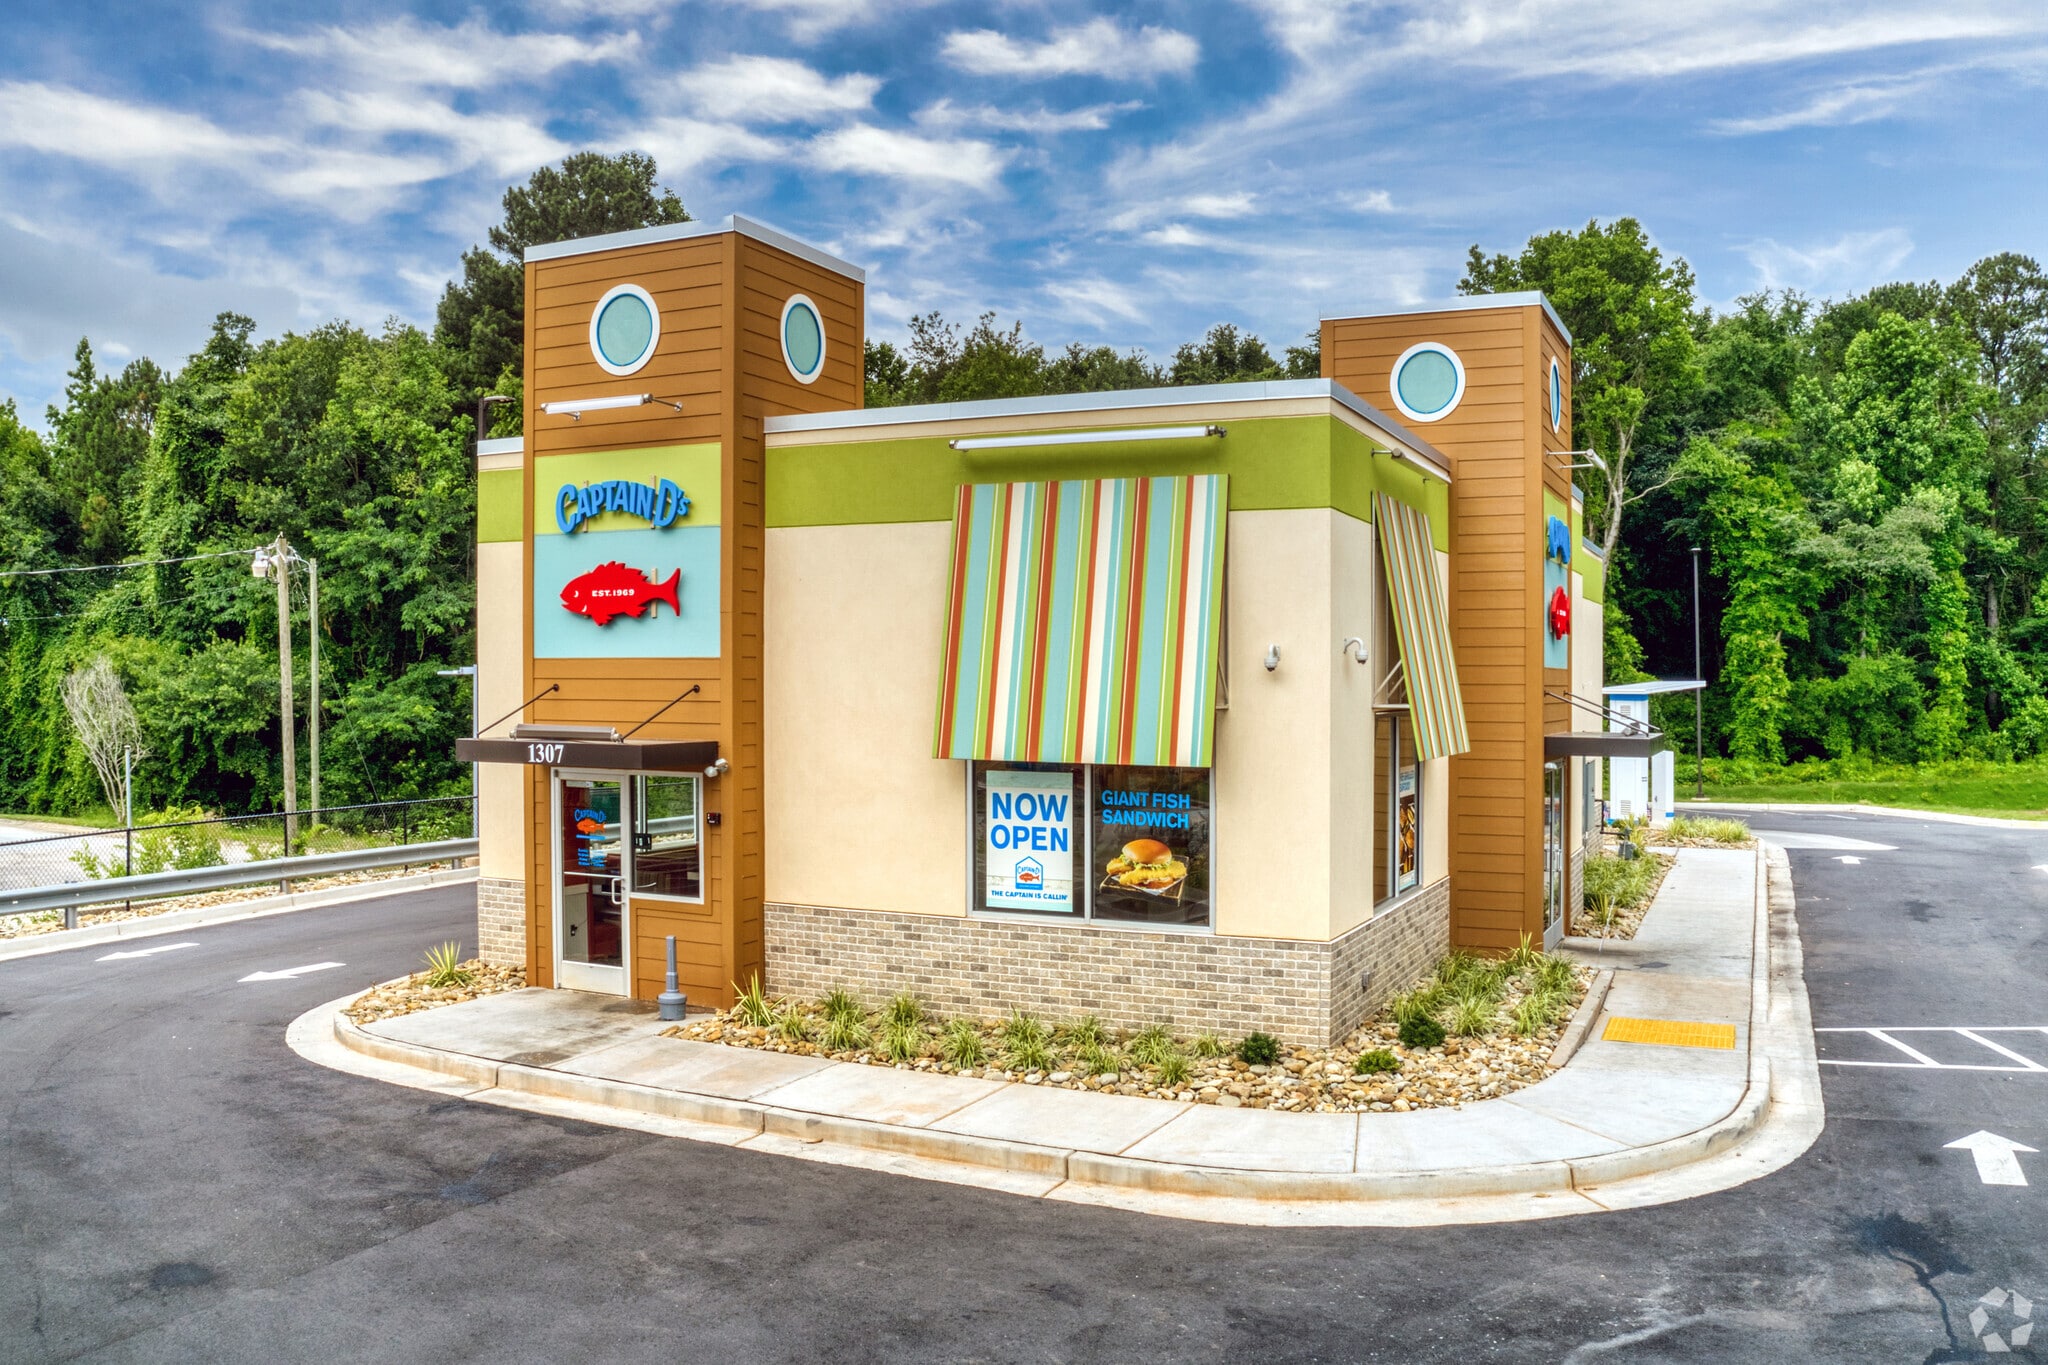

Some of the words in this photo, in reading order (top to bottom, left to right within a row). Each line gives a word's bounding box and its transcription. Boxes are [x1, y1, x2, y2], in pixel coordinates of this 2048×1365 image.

[555, 480, 655, 534] CAPTAIN
[612, 588, 635, 597] 1969
[527, 743, 564, 764] 1307
[991, 792, 1068, 822] NOW
[1101, 789, 1149, 807] GIANT
[1152, 793, 1191, 809] FISH
[1102, 809, 1189, 829] SANDWICH
[990, 824, 1068, 852] OPEN
[1005, 891, 1034, 899] CAPTAIN
